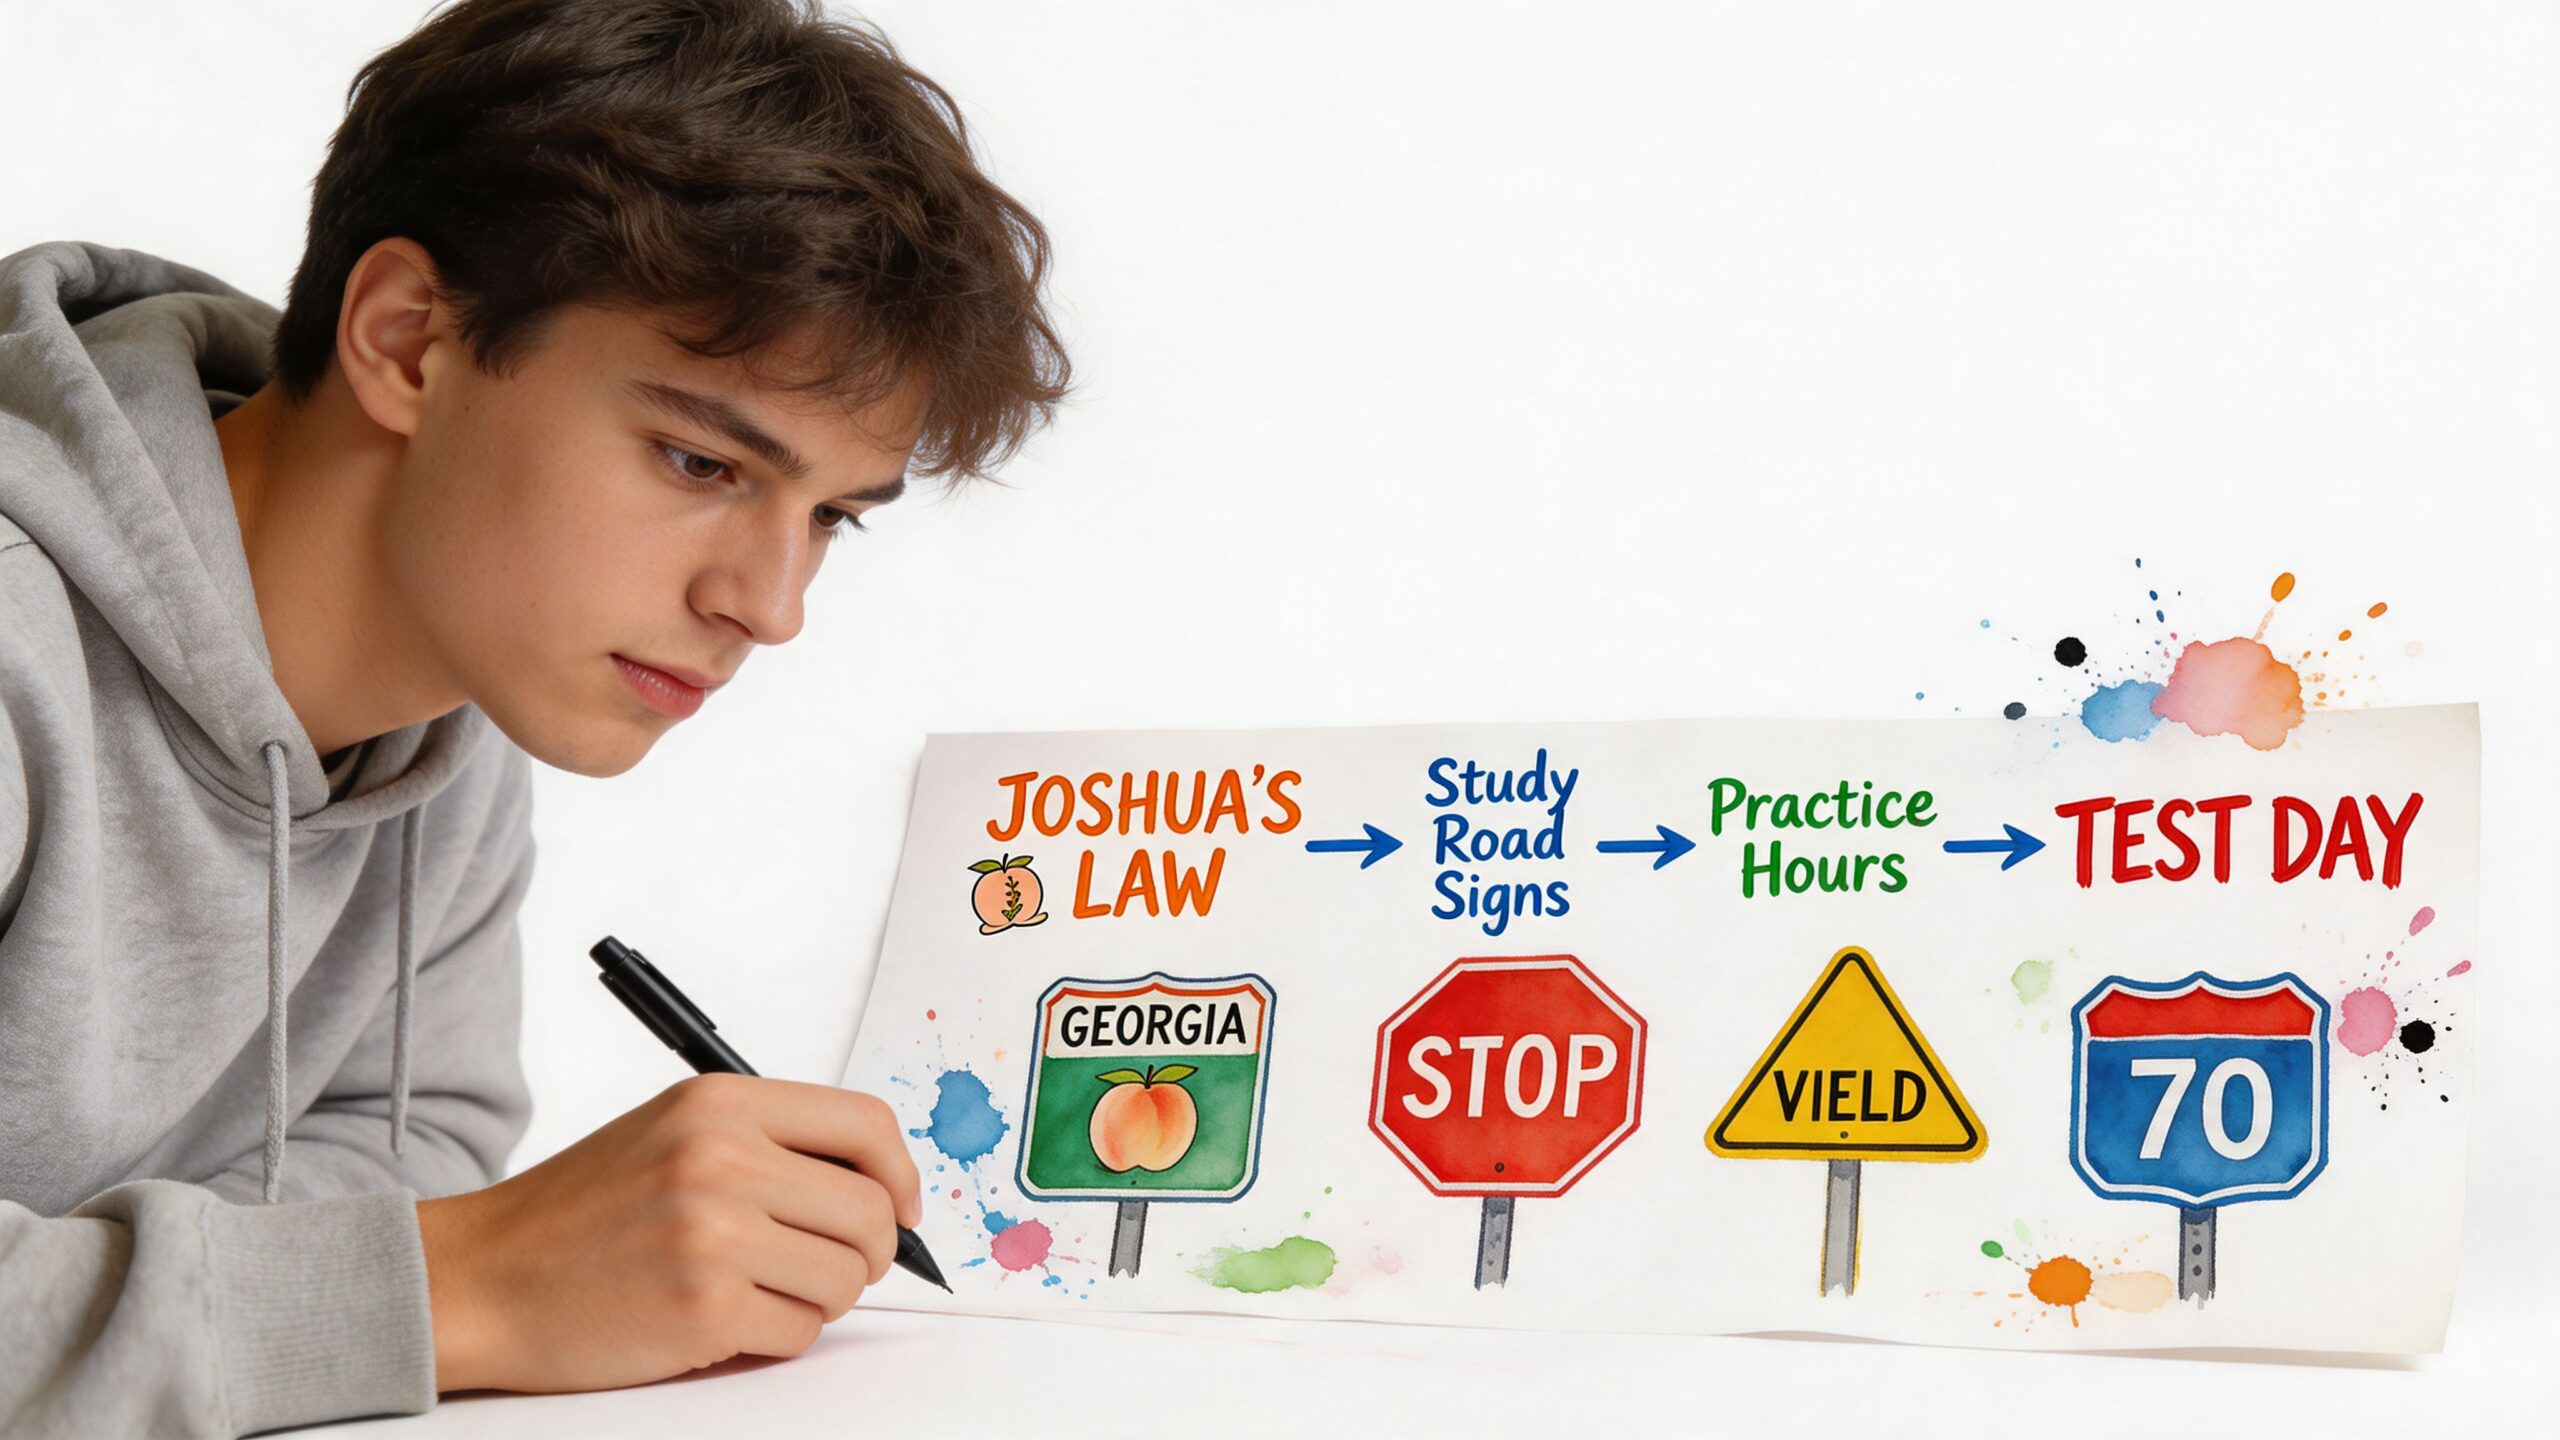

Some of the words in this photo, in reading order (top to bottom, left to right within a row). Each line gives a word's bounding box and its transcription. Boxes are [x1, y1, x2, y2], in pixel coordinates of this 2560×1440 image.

[1425, 748, 1579, 814] Study
[1708, 778, 1937, 836] Practice
[1433, 813, 1565, 864] Road
[1741, 841, 1907, 898] Hours
[2055, 795, 2252, 888] TEST
[2272, 793, 2423, 889] DAY
[1073, 848, 1226, 918] LAW
[1431, 871, 1570, 935] Signs
[1060, 1003, 1247, 1047] GEORGIA
[1402, 1034, 1617, 1119] STOP
[2130, 1058, 2272, 1161] 70
